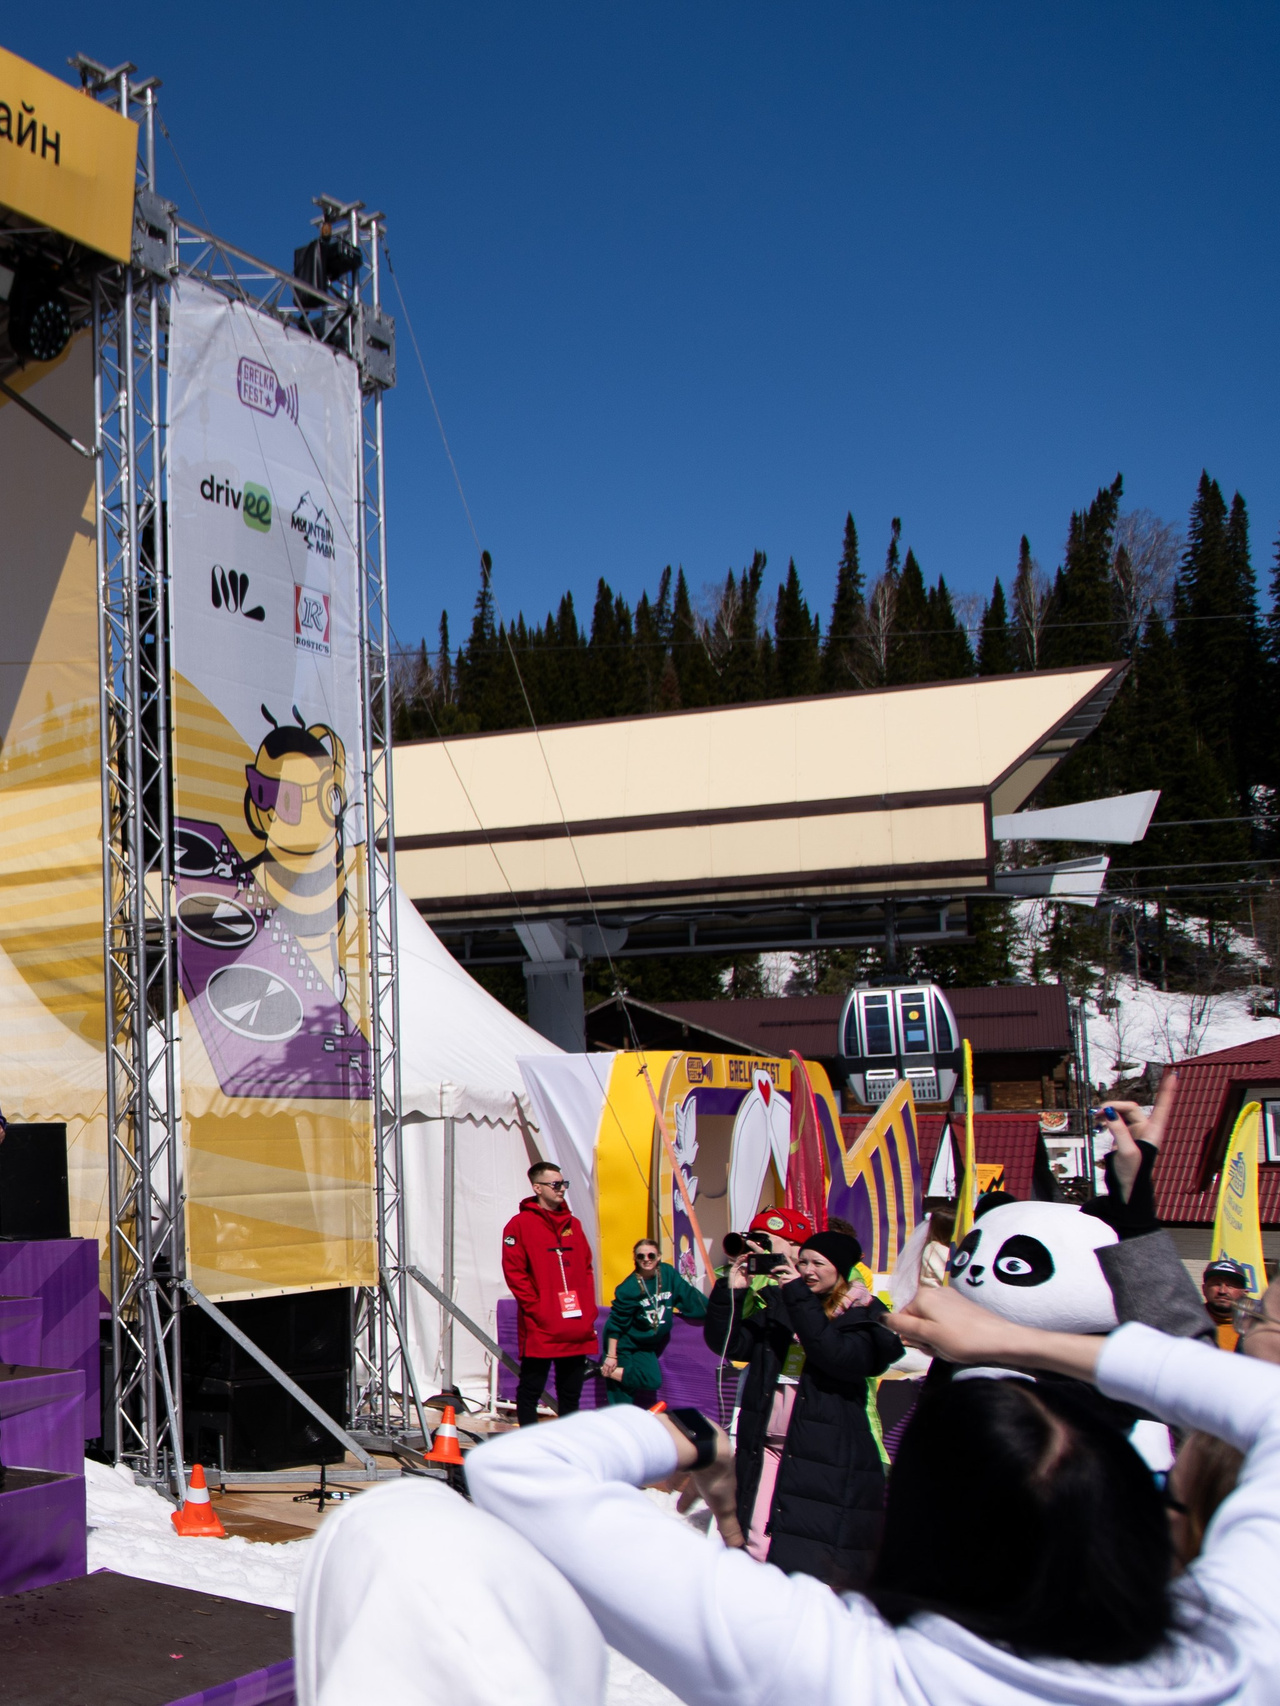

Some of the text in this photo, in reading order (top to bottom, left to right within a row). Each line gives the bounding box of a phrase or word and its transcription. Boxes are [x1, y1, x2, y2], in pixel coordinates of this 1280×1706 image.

[243, 363, 275, 393] GRELKA
[243, 382, 264, 405] FEST
[200, 474, 272, 526] drivee
[291, 514, 334, 545] MOUNTAIN
[315, 540, 336, 561] MAN
[295, 636, 330, 654] ROSTIC'S
